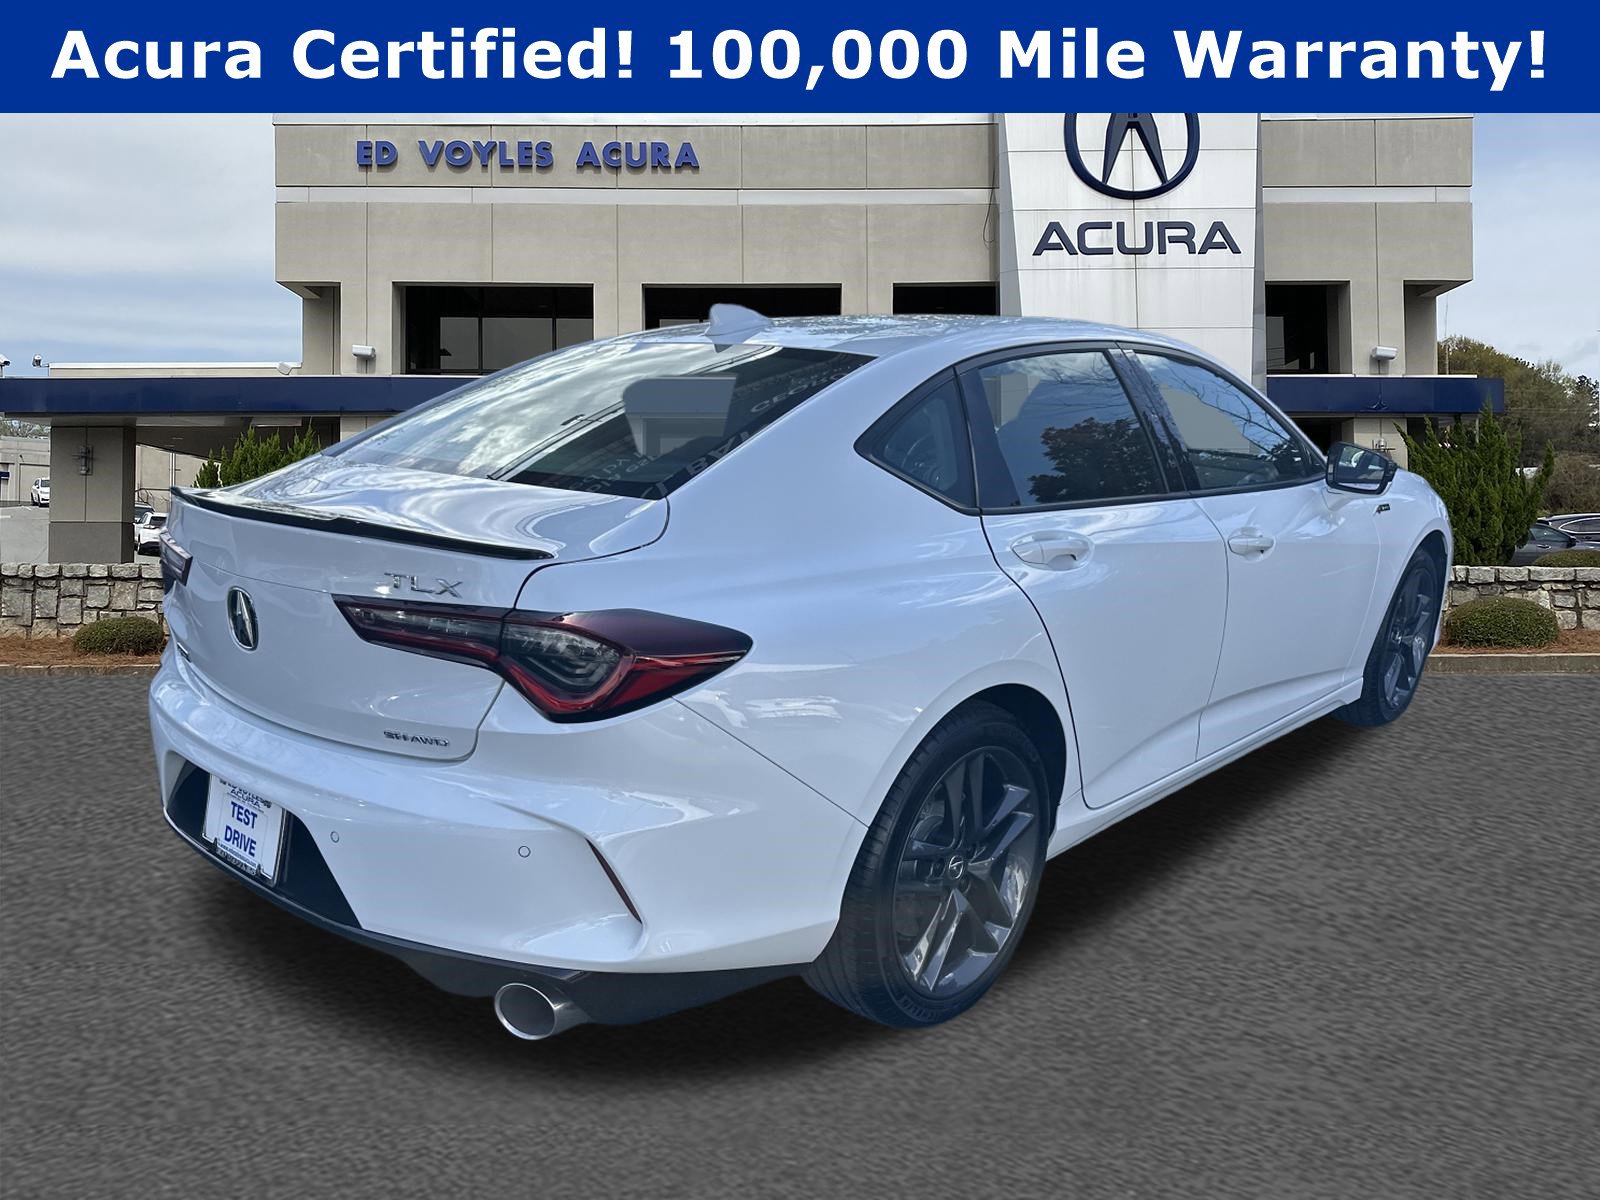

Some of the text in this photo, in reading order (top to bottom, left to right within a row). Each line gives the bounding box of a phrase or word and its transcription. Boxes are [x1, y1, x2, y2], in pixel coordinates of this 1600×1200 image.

[356, 140, 700, 169] ED VOYLES ACURA
[1032, 220, 1242, 257] ACURA
[383, 572, 463, 598] TLX
[230, 800, 258, 829] TEST
[224, 824, 257, 858] DRIVE
